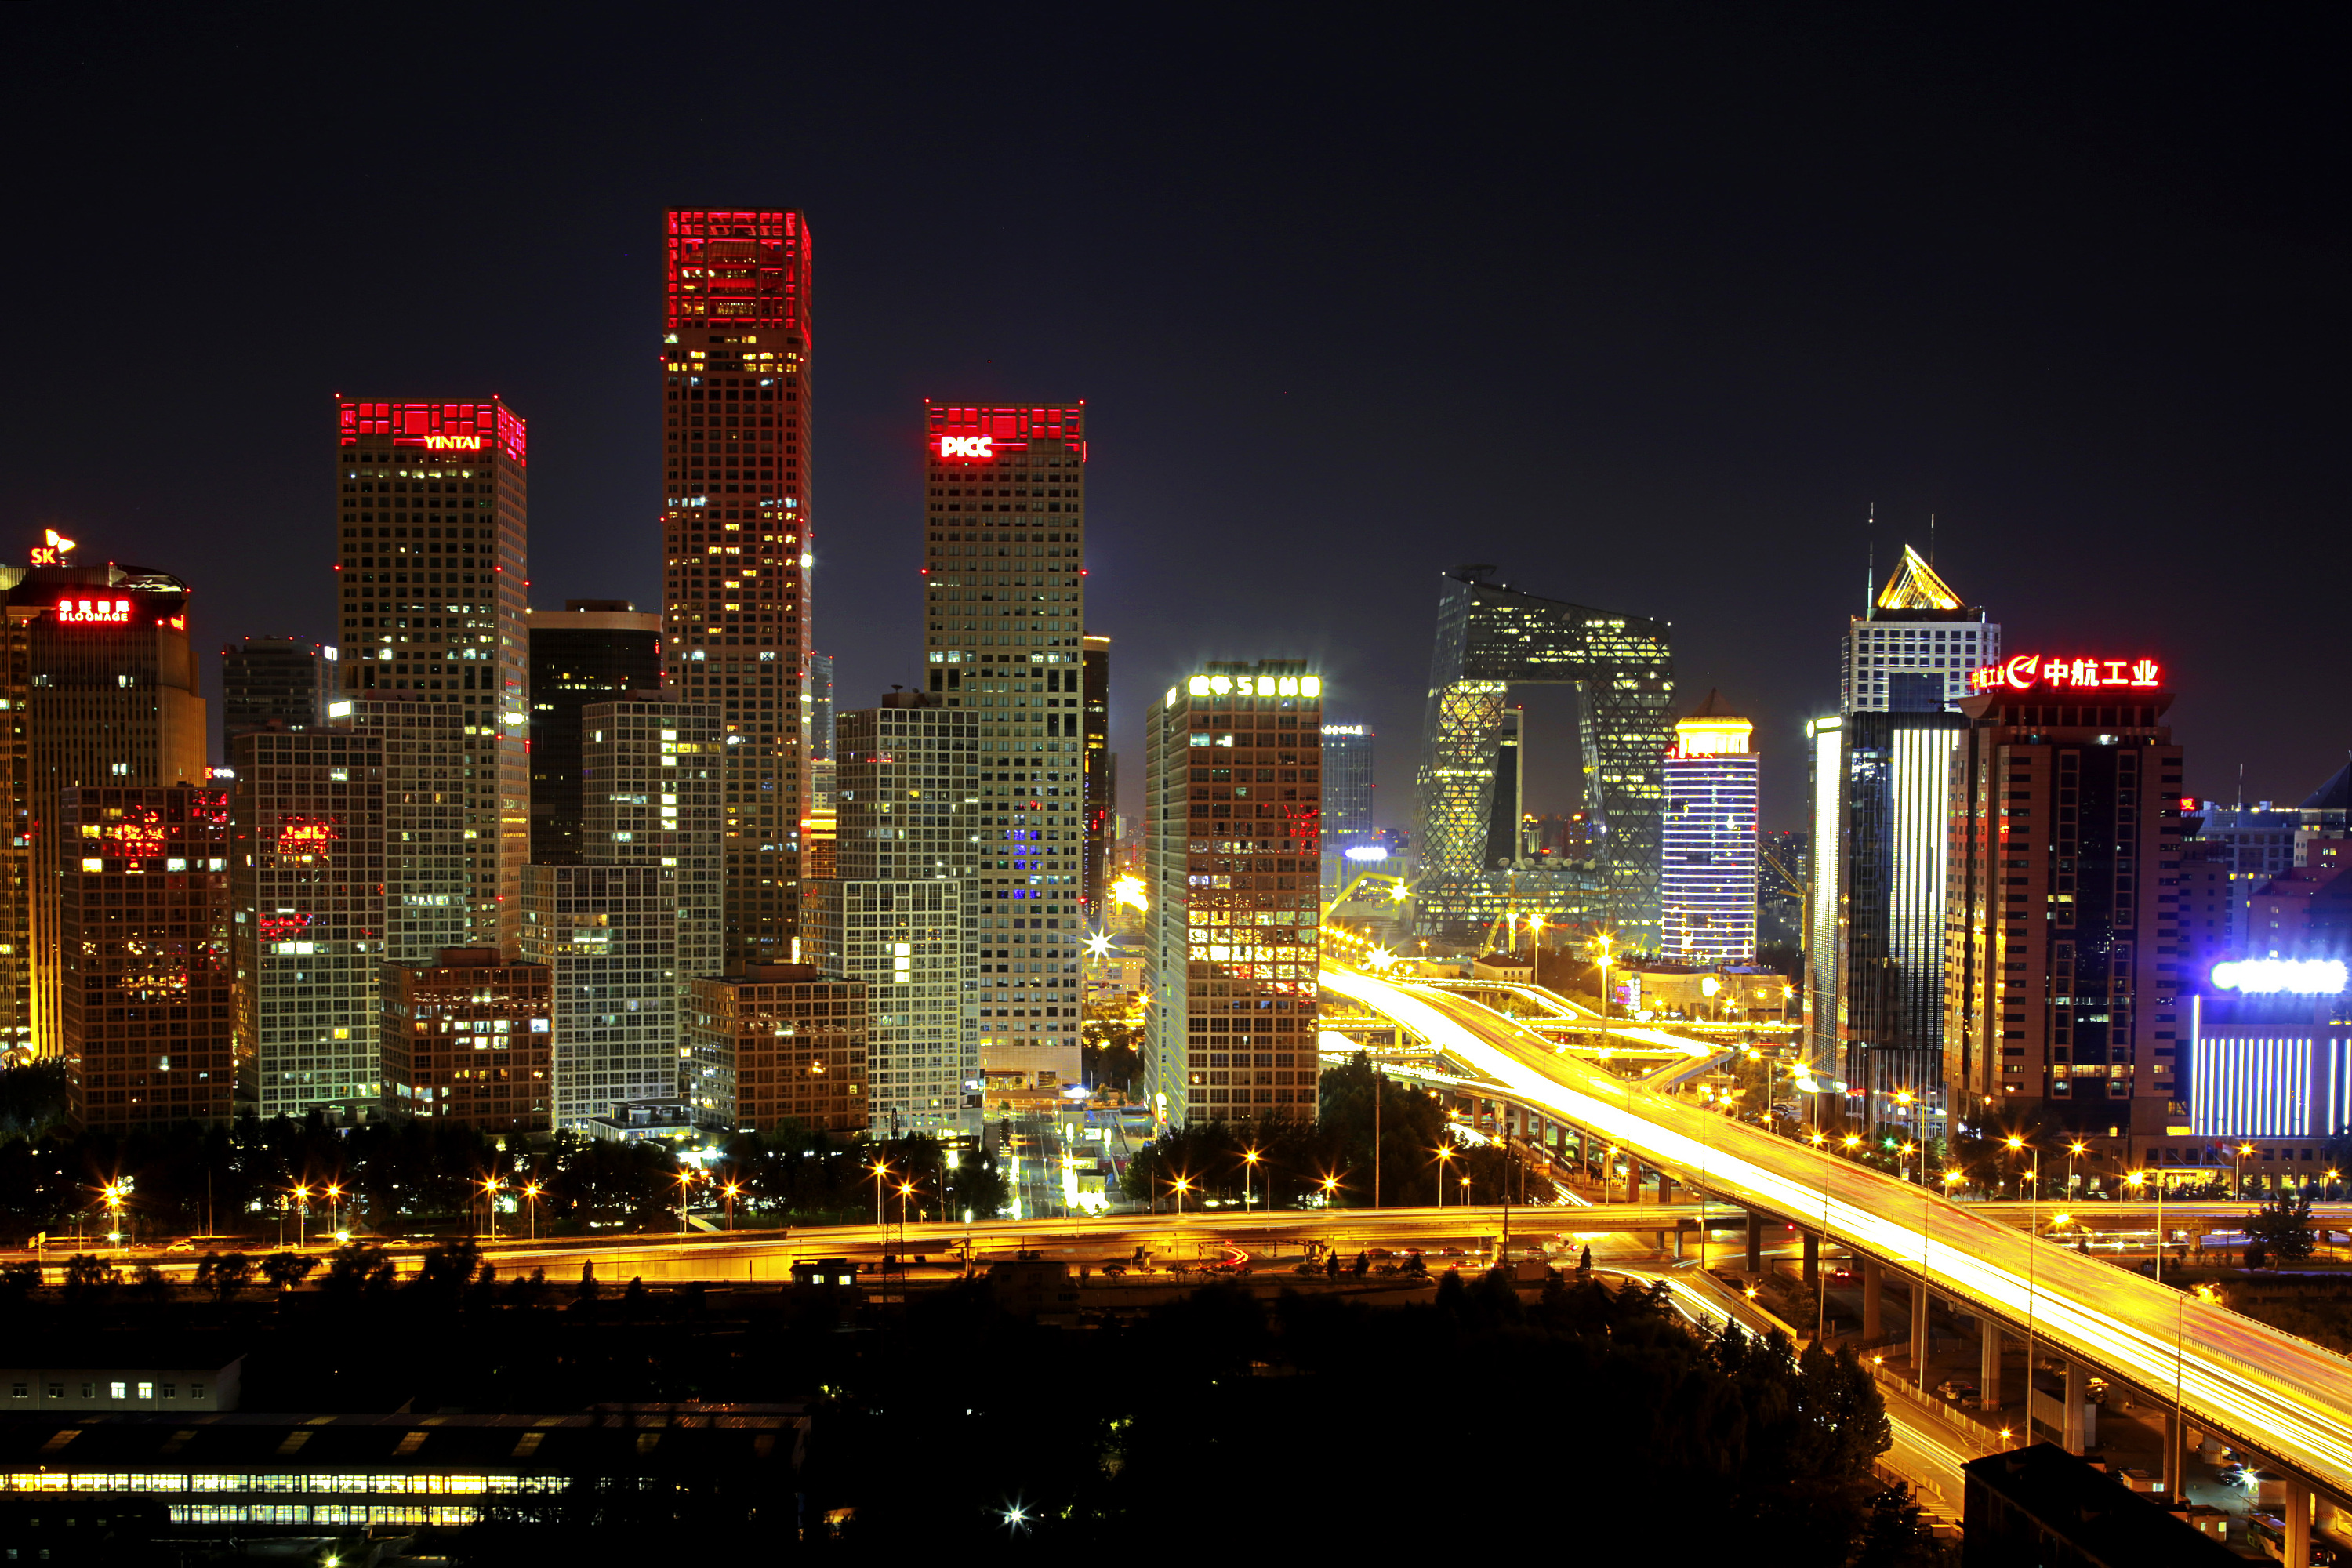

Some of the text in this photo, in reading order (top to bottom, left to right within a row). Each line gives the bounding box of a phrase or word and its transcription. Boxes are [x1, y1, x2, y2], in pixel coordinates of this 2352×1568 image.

[424, 435, 481, 449] YINTAI
[941, 436, 993, 457] PICC
[31, 548, 56, 564] SK
[60, 612, 129, 622] BLOOMAGE
[2043, 658, 2159, 687] 中航工业
